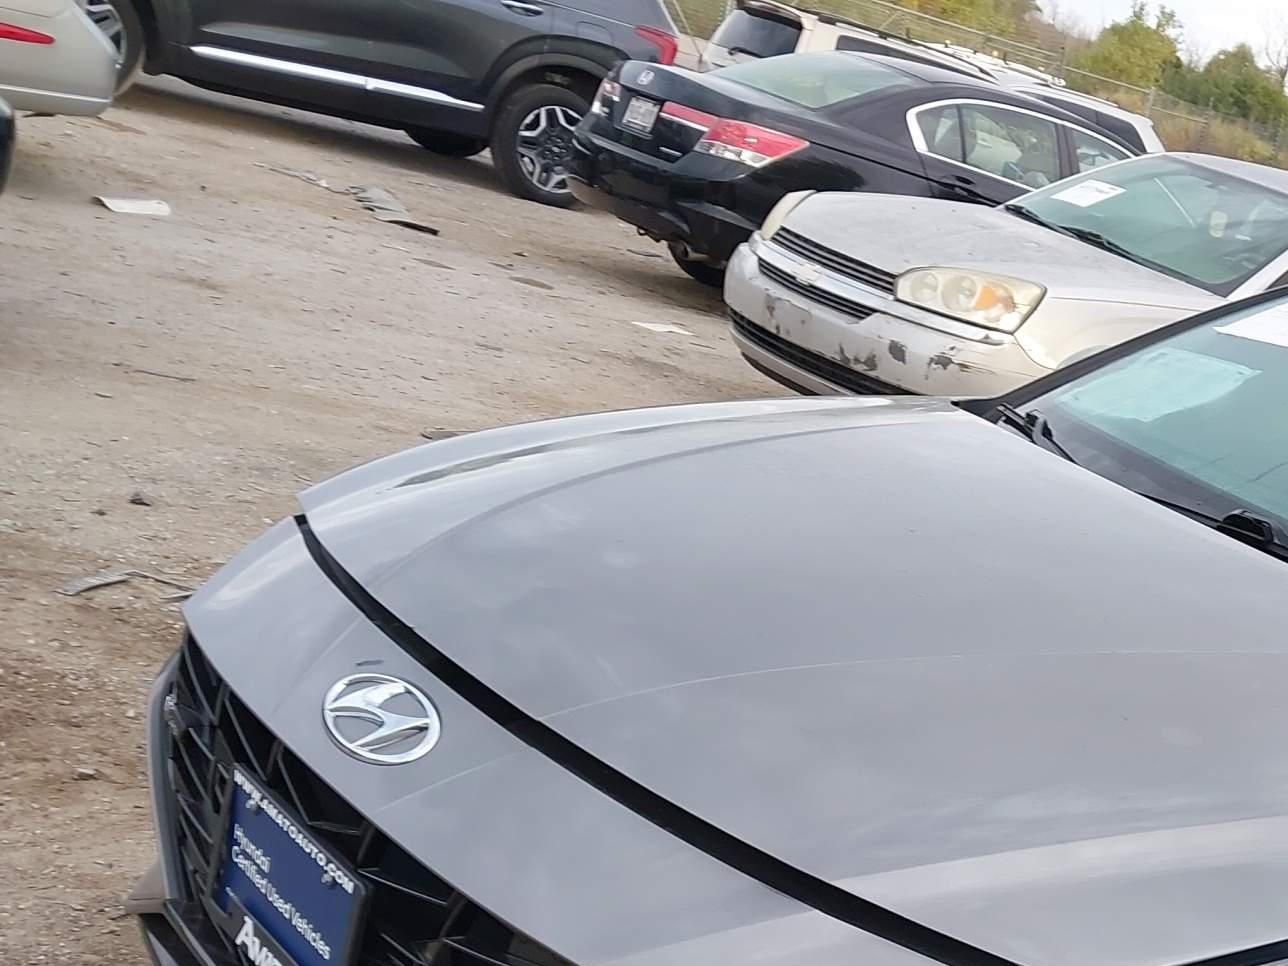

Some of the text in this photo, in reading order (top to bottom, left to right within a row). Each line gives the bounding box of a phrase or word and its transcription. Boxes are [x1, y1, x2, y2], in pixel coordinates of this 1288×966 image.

[233, 768, 355, 894] WWW.AMATOAUTO.COM
[233, 823, 271, 874] Hyundai
[231, 845, 268, 896] Certified
[265, 881, 292, 920] Used
[290, 905, 332, 961] Vehicles
